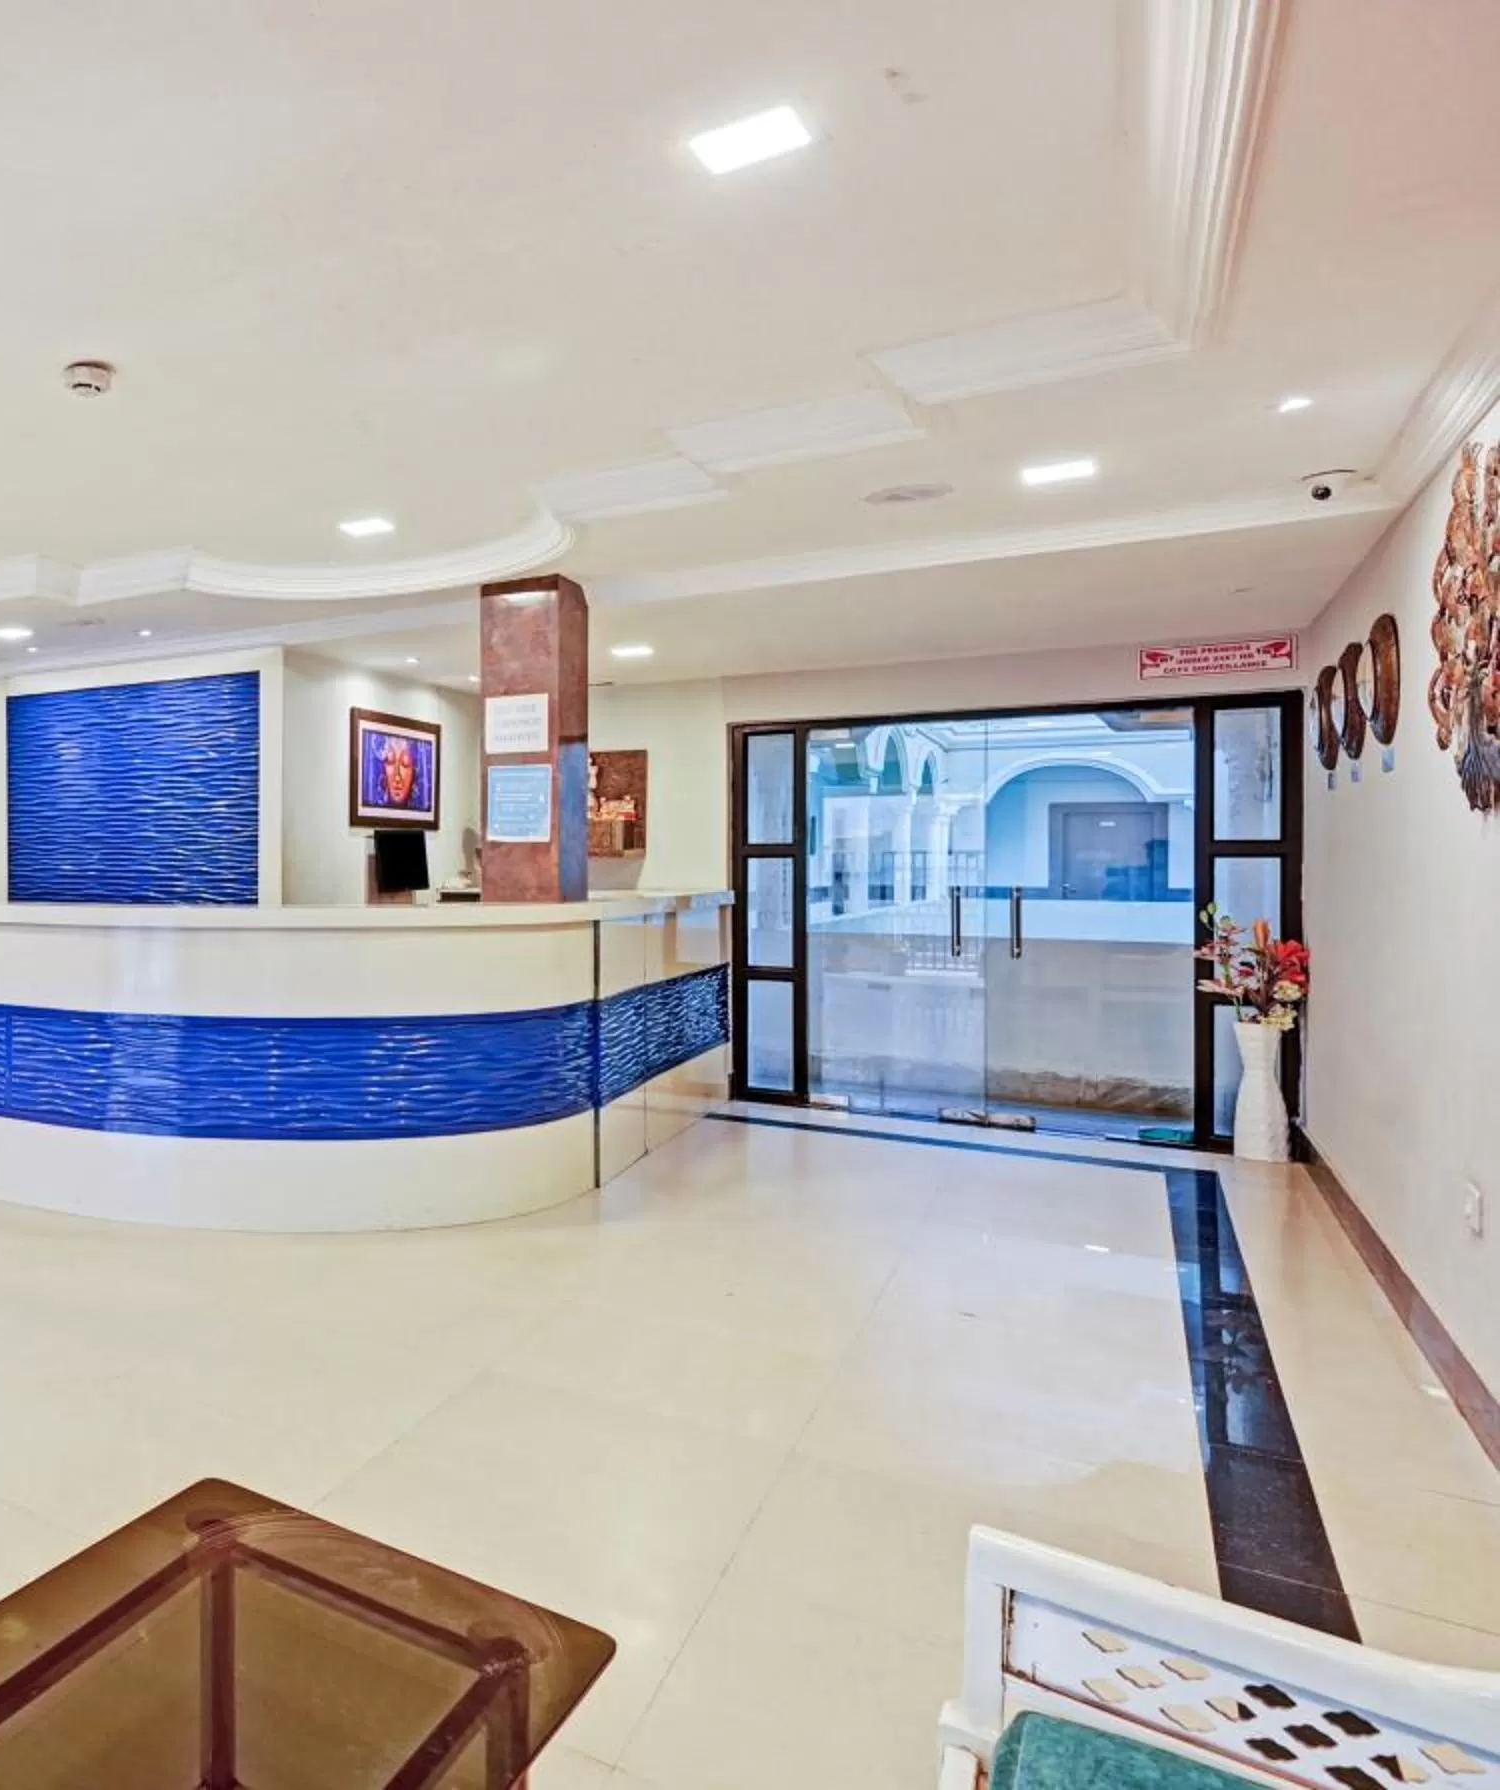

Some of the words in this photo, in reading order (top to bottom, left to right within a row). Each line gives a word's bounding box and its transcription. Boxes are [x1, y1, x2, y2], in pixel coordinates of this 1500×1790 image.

[1180, 648, 1198, 656] THE
[1176, 656, 1210, 664] UNDER
[1163, 666, 1189, 674] CCTV
